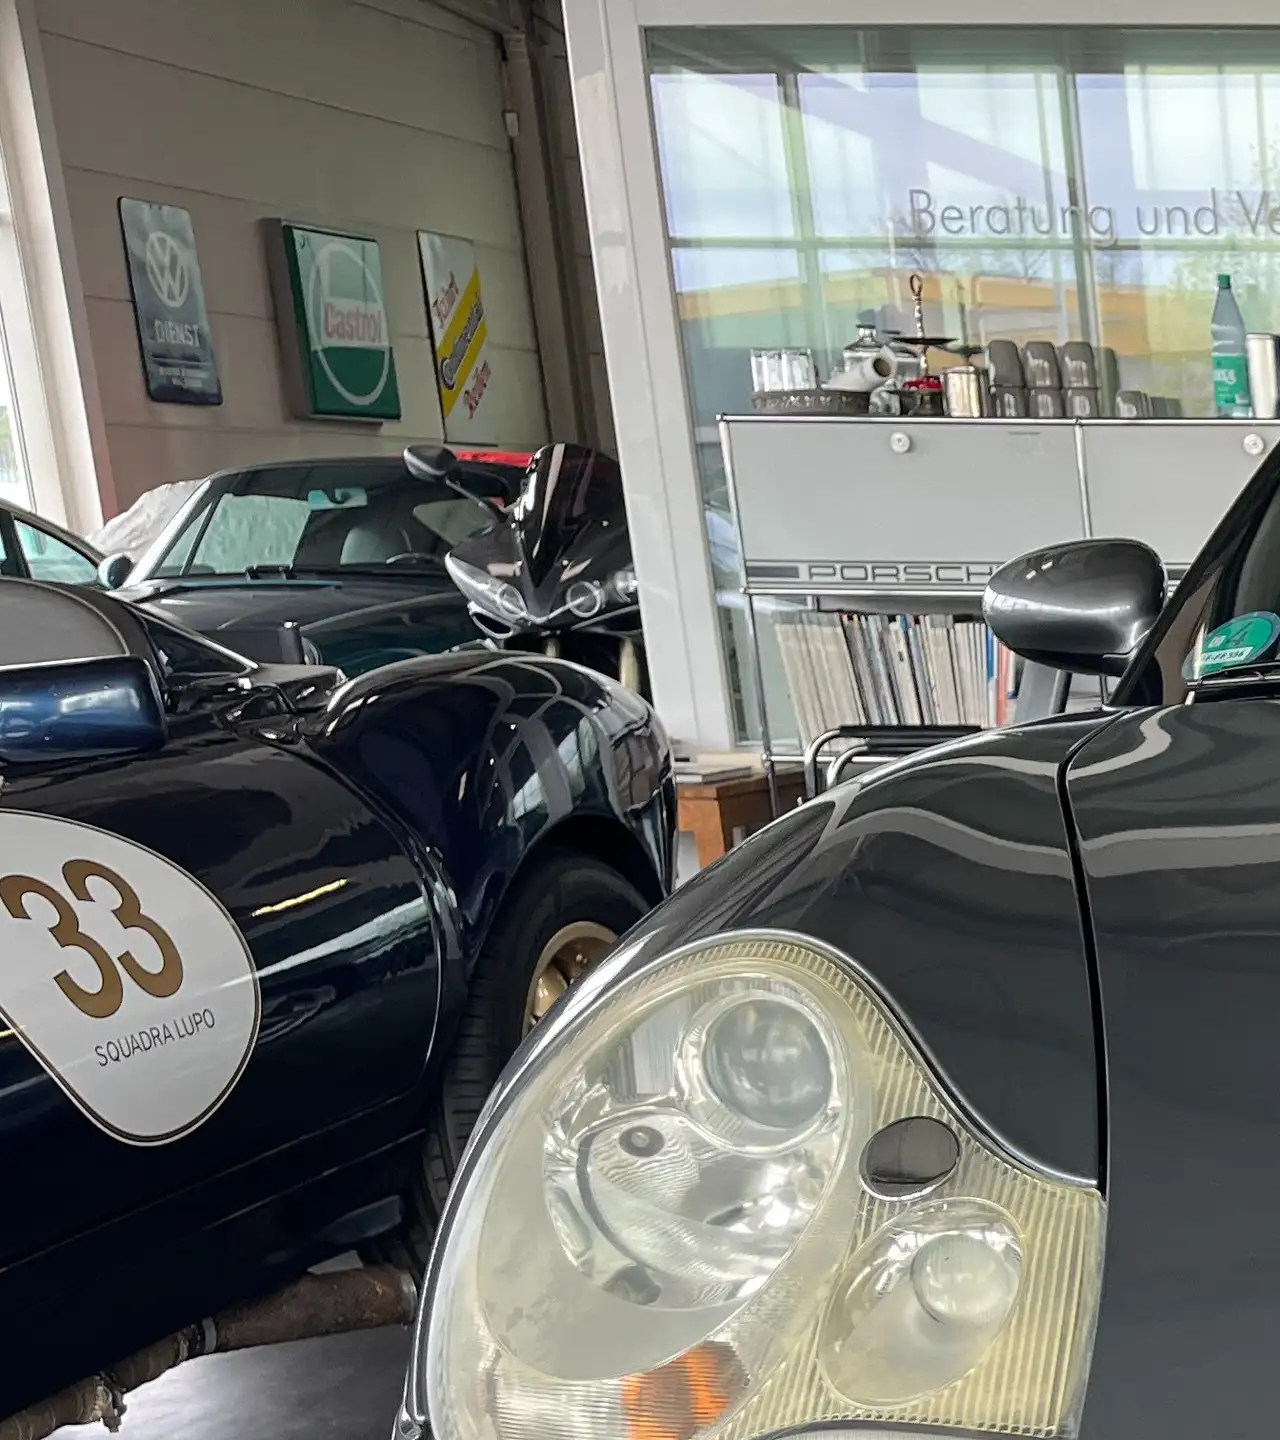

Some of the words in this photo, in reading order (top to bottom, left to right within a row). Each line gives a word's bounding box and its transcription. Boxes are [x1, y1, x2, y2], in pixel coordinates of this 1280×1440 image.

[907, 187, 1117, 247] Beratung
[1136, 187, 1220, 236] und
[154, 318, 201, 348] DIENST
[324, 301, 382, 345] Castrol
[808, 564, 1000, 584] PORSCH
[0, 858, 184, 1019] 33
[95, 1022, 176, 1067] SQUADRA
[178, 1008, 216, 1040] LUPO
